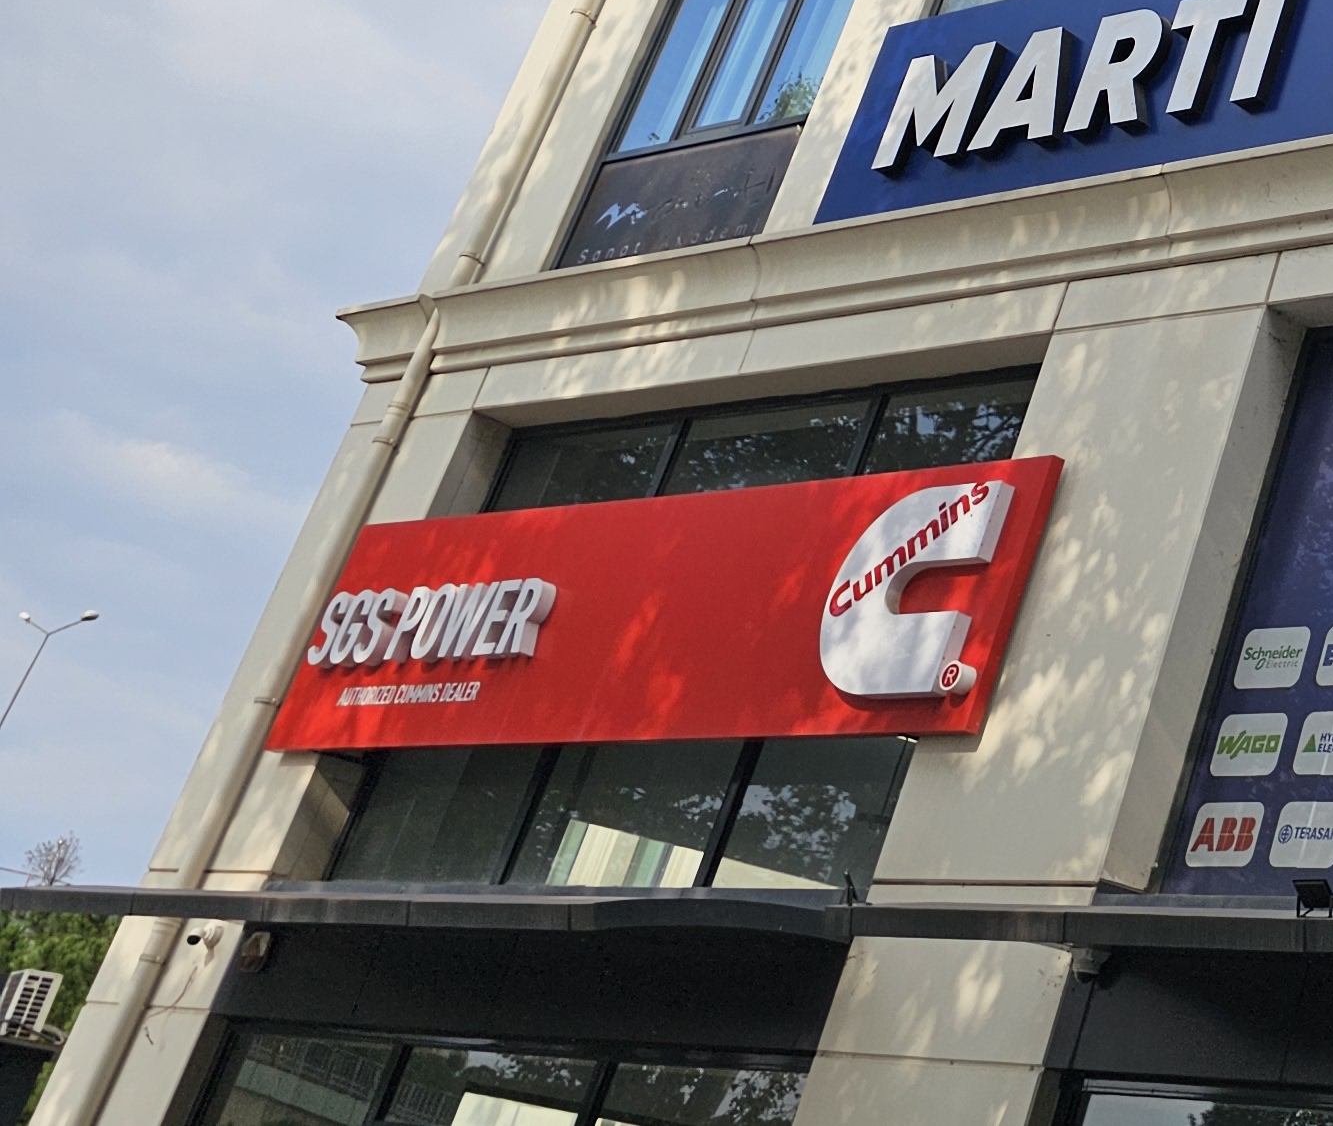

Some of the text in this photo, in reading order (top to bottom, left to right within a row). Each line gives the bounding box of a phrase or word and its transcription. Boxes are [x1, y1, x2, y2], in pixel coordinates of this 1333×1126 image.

[829, 481, 990, 617] Cummins
[308, 577, 556, 667] SGS POWER
[1243, 646, 1303, 661] Schneider
[1265, 658, 1299, 669] Electric
[336, 681, 481, 707] AUTHORIZED CUMMINS DEALER
[1217, 730, 1281, 760] WAGO
[1190, 816, 1257, 853] ABB
